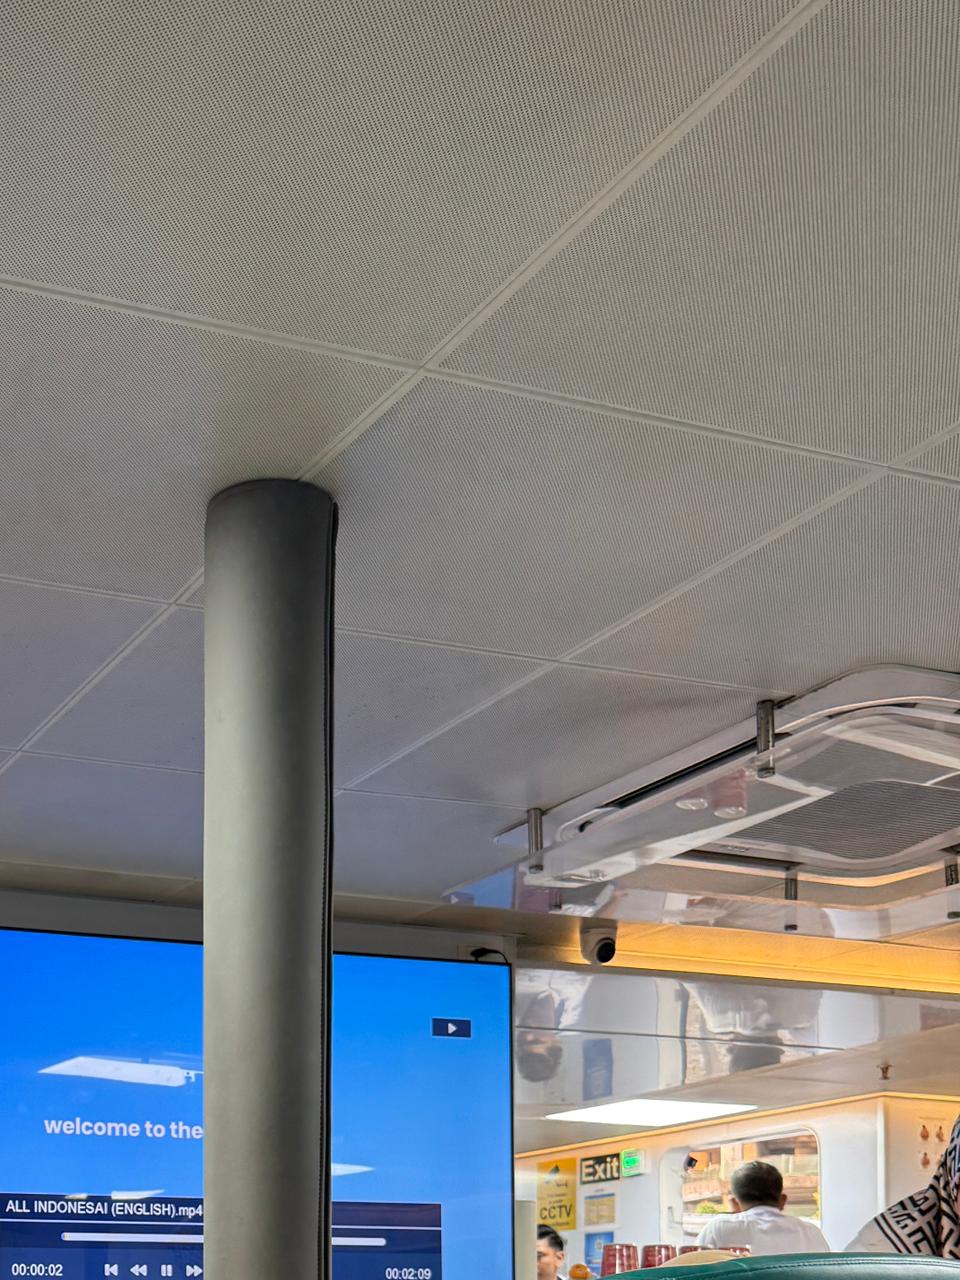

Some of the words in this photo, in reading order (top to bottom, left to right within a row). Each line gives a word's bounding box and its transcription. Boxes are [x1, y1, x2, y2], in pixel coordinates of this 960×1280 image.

[43, 1117, 141, 1137] welcome
[144, 1121, 166, 1138] to
[170, 1121, 204, 1139] the
[581, 1157, 619, 1181] Exit
[6, 1199, 30, 1213] ALL
[34, 1200, 108, 1215] INDONESAI
[111, 1202, 203, 1219] (ENGLISH).mp4
[540, 1204, 573, 1220] CCTV
[11, 1263, 63, 1277] 00:00:02
[385, 1267, 432, 1280] 00:02:09
